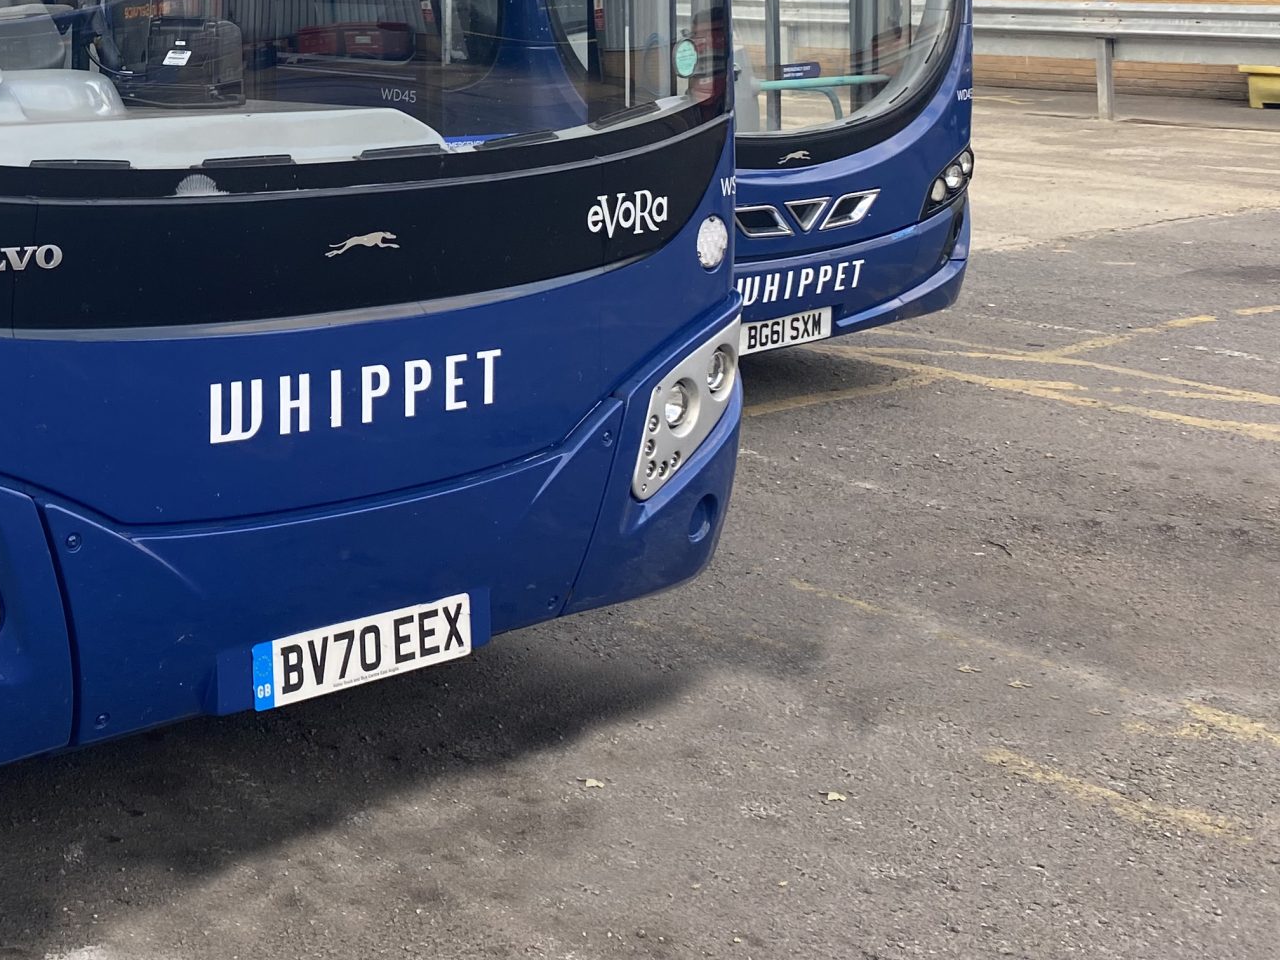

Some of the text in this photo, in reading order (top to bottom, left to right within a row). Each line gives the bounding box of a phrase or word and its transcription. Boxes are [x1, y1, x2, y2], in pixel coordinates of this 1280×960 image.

[380, 87, 417, 103] WD45
[736, 259, 865, 307] WHIPPET
[747, 312, 822, 350] BG61 SXM
[209, 348, 502, 444] WHIPPET
[280, 602, 464, 695] BV70 EEX
[257, 683, 272, 699] GB
